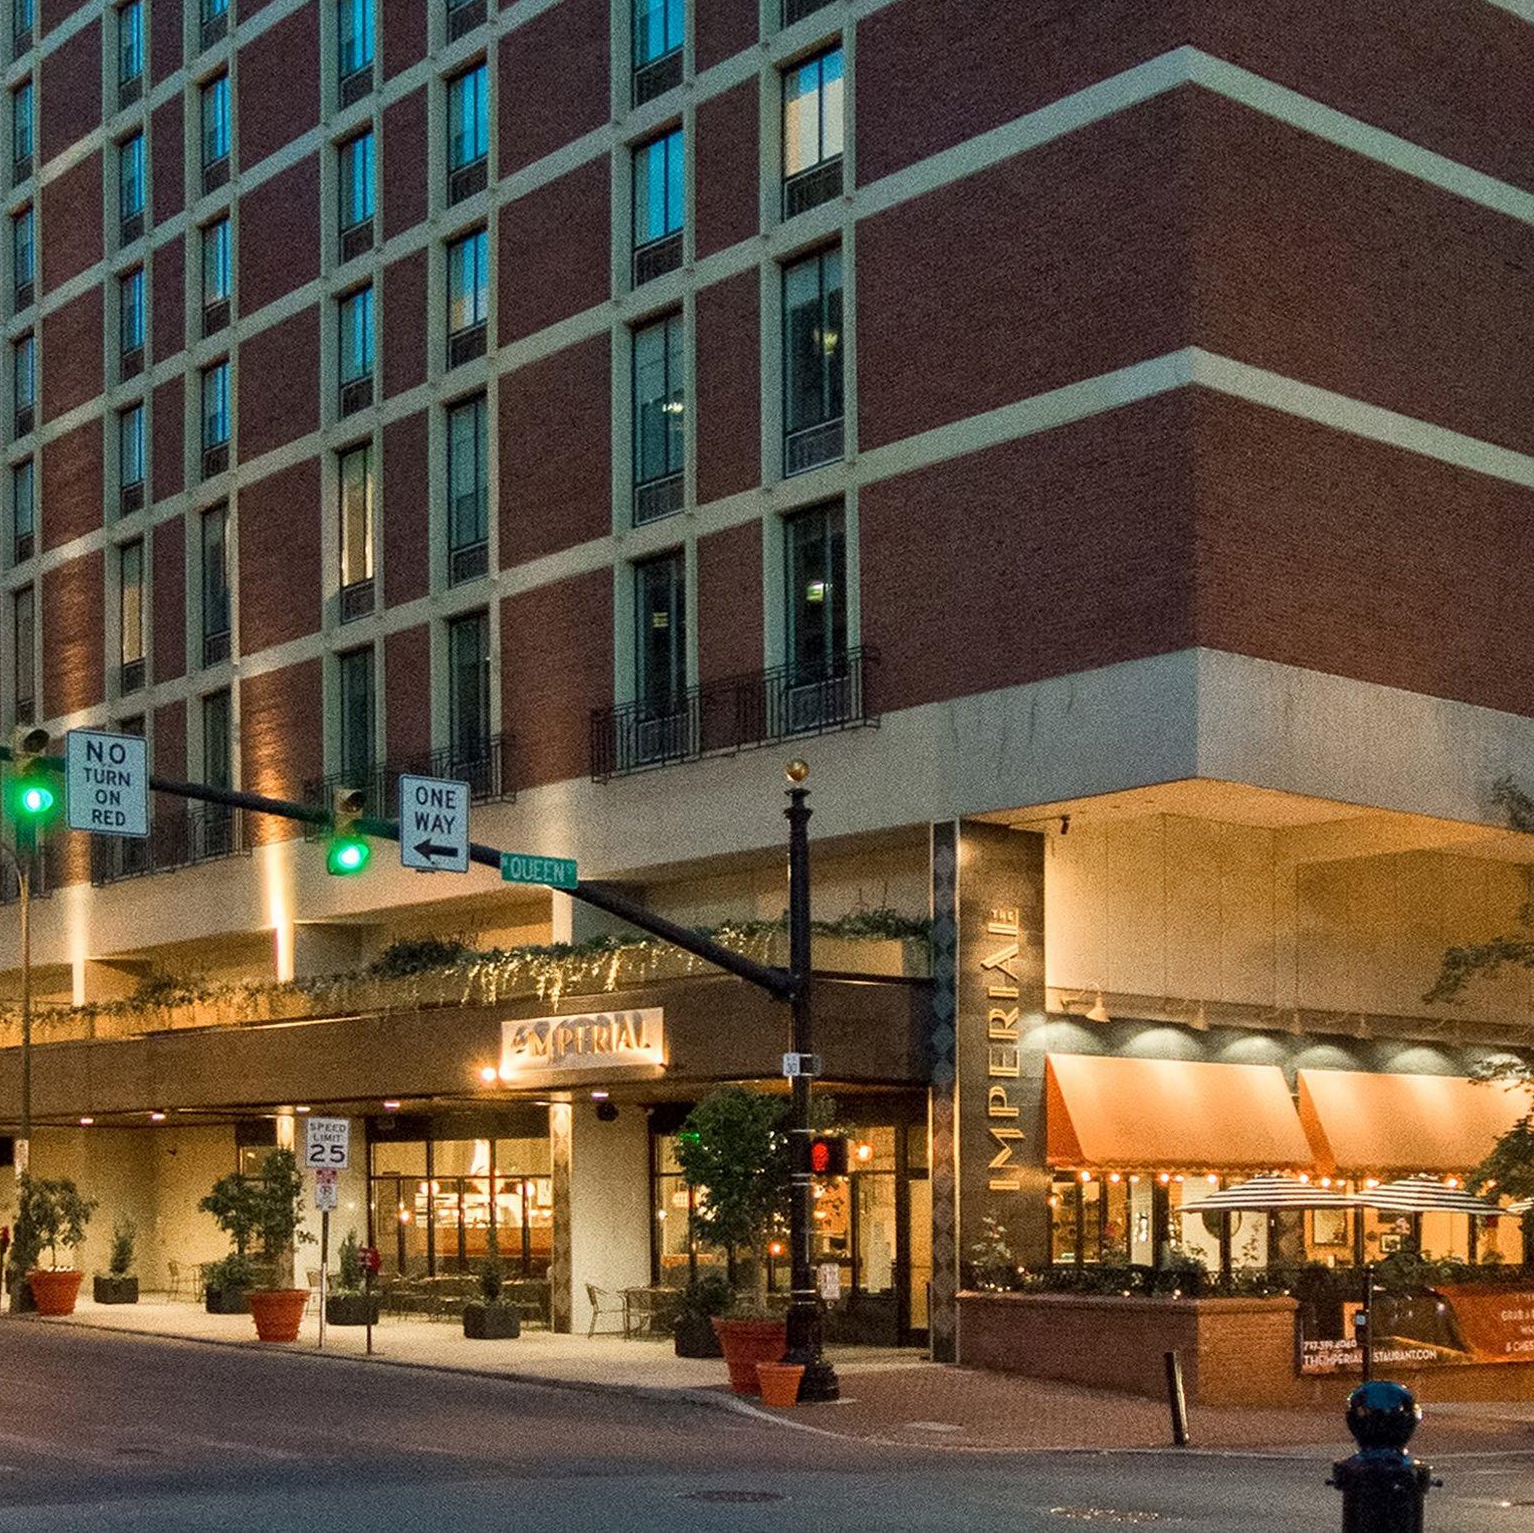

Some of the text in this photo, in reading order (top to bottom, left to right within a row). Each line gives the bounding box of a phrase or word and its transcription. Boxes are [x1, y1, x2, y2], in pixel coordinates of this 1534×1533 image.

[87, 740, 126, 764] NO
[83, 767, 131, 786] TURN
[95, 789, 120, 806] ON
[416, 786, 456, 809] ONE
[92, 809, 125, 826] RED
[414, 811, 456, 834] WAY
[510, 857, 565, 882] QUEEN
[991, 908, 1013, 920] THE
[980, 908, 1025, 1189] IMPERIAL
[310, 1122, 346, 1132] SPEED
[313, 1133, 341, 1142] LIMIT
[309, 1144, 345, 1163] 25
